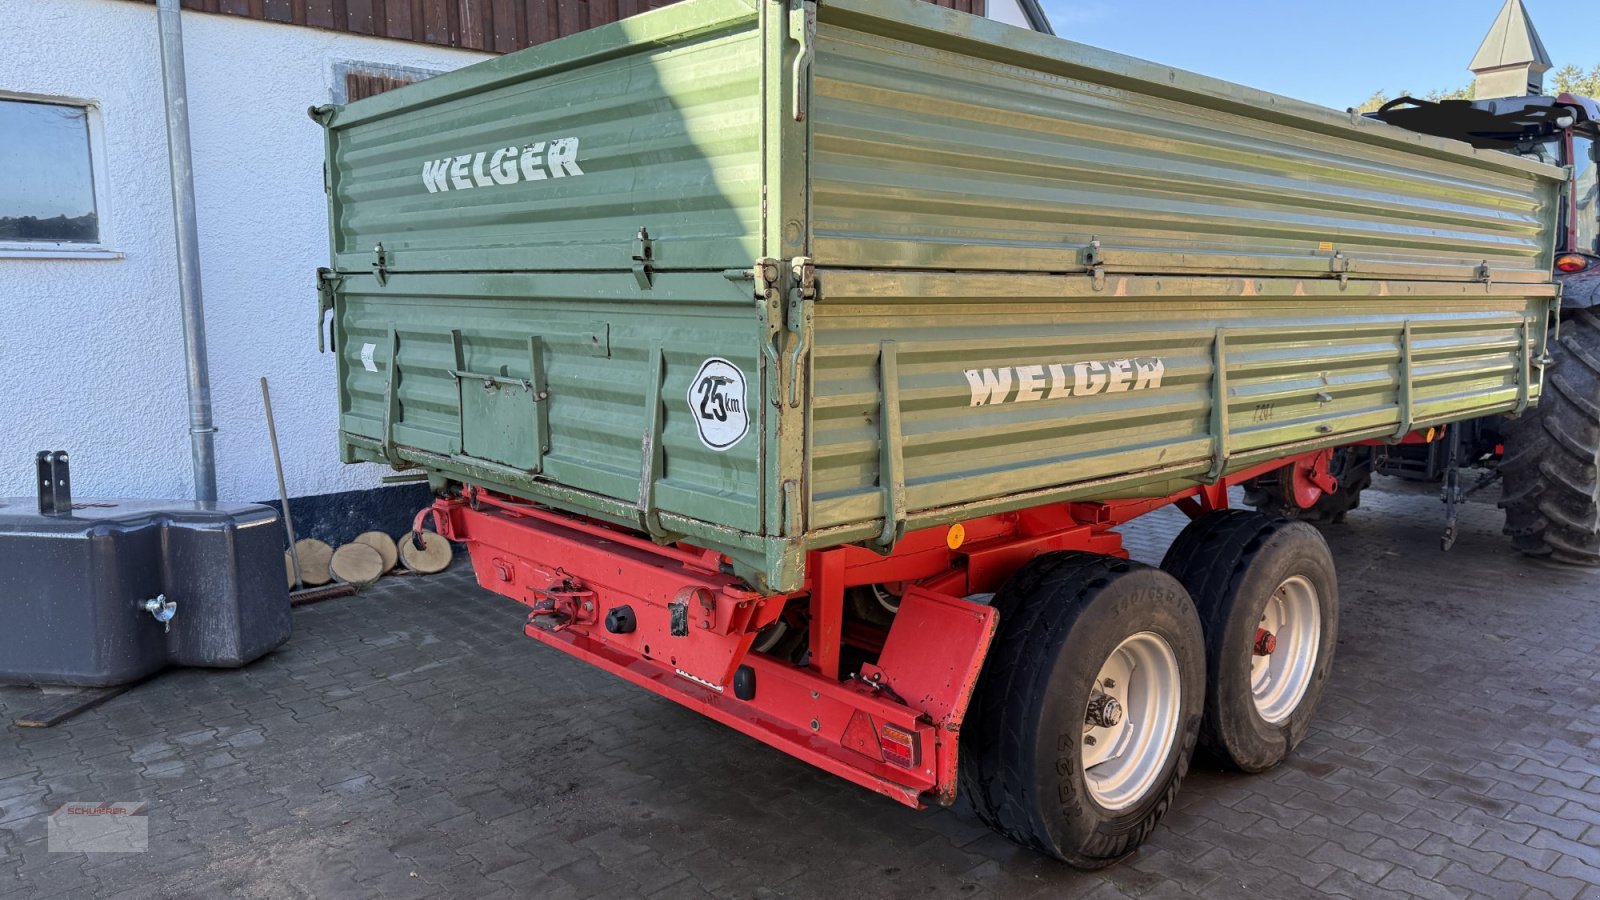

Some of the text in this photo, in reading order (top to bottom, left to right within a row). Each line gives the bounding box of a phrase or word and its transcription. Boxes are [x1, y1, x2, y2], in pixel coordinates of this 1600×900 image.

[422, 137, 585, 194] WELGER
[698, 376, 741, 422] 25 km
[963, 358, 1165, 407] WELGER
